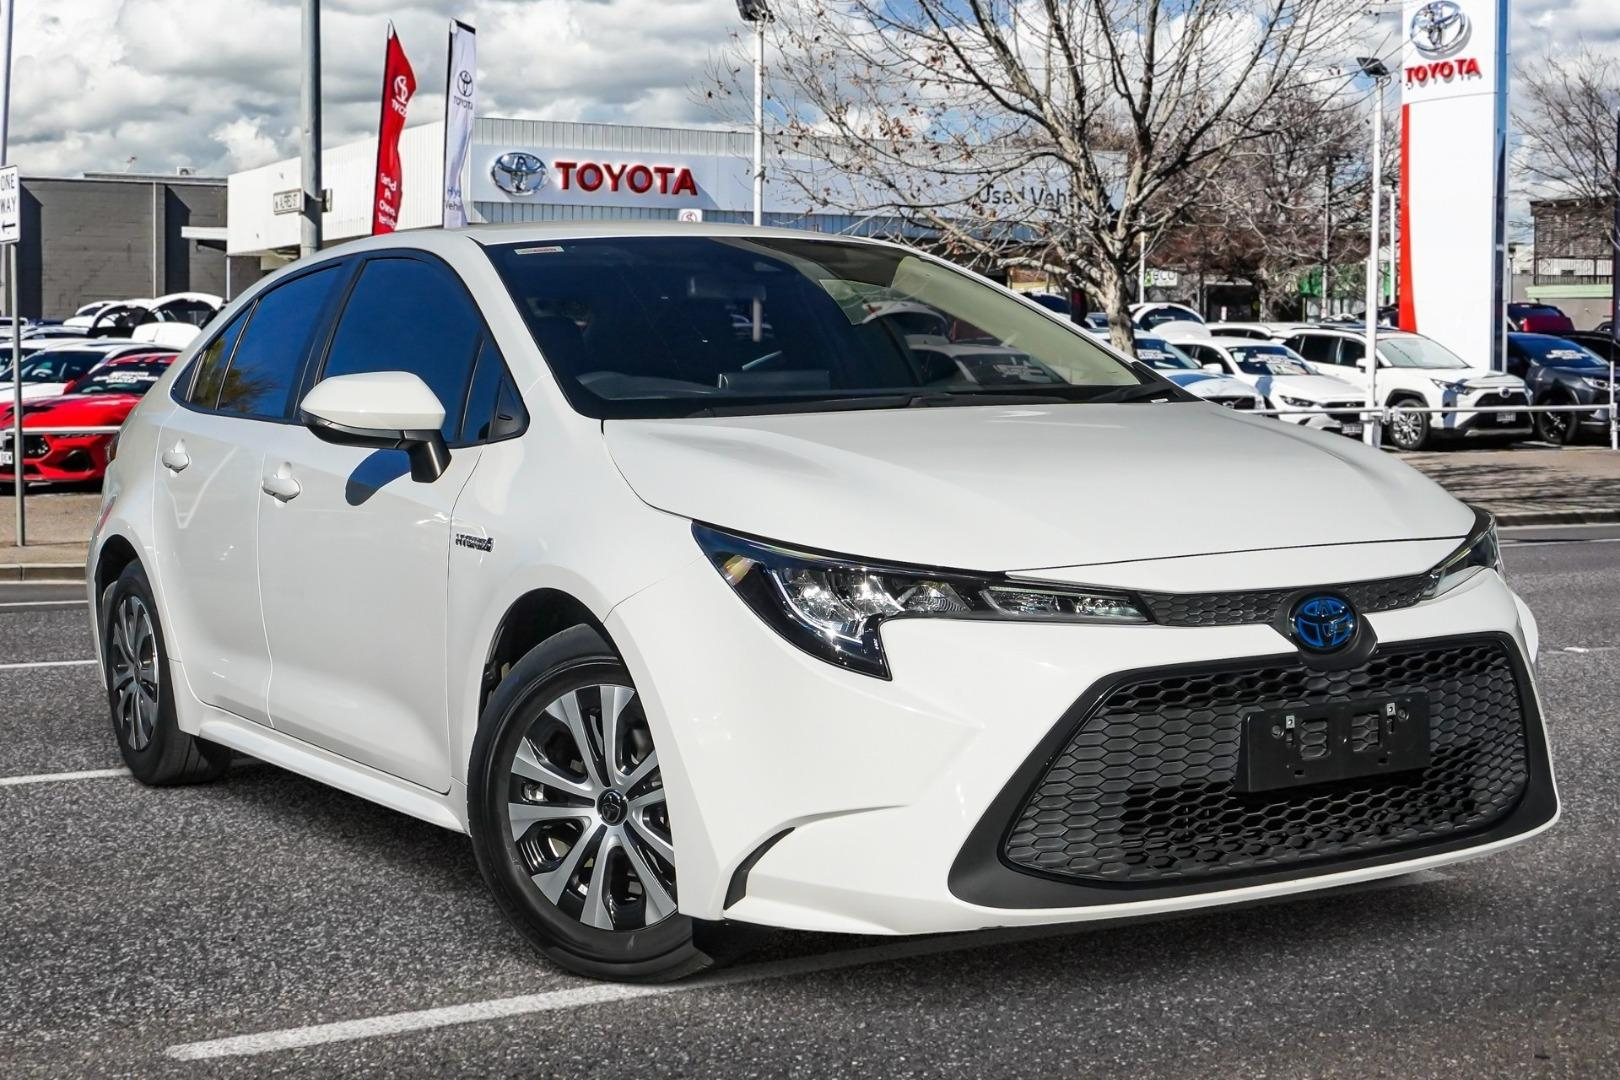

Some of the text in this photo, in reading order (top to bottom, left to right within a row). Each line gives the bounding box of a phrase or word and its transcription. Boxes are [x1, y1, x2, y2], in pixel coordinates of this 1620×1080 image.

[1405, 58, 1481, 83] TOYOTA
[1, 173, 15, 191] ONE
[555, 162, 698, 196] TOYOTA
[1, 196, 16, 214] WAY
